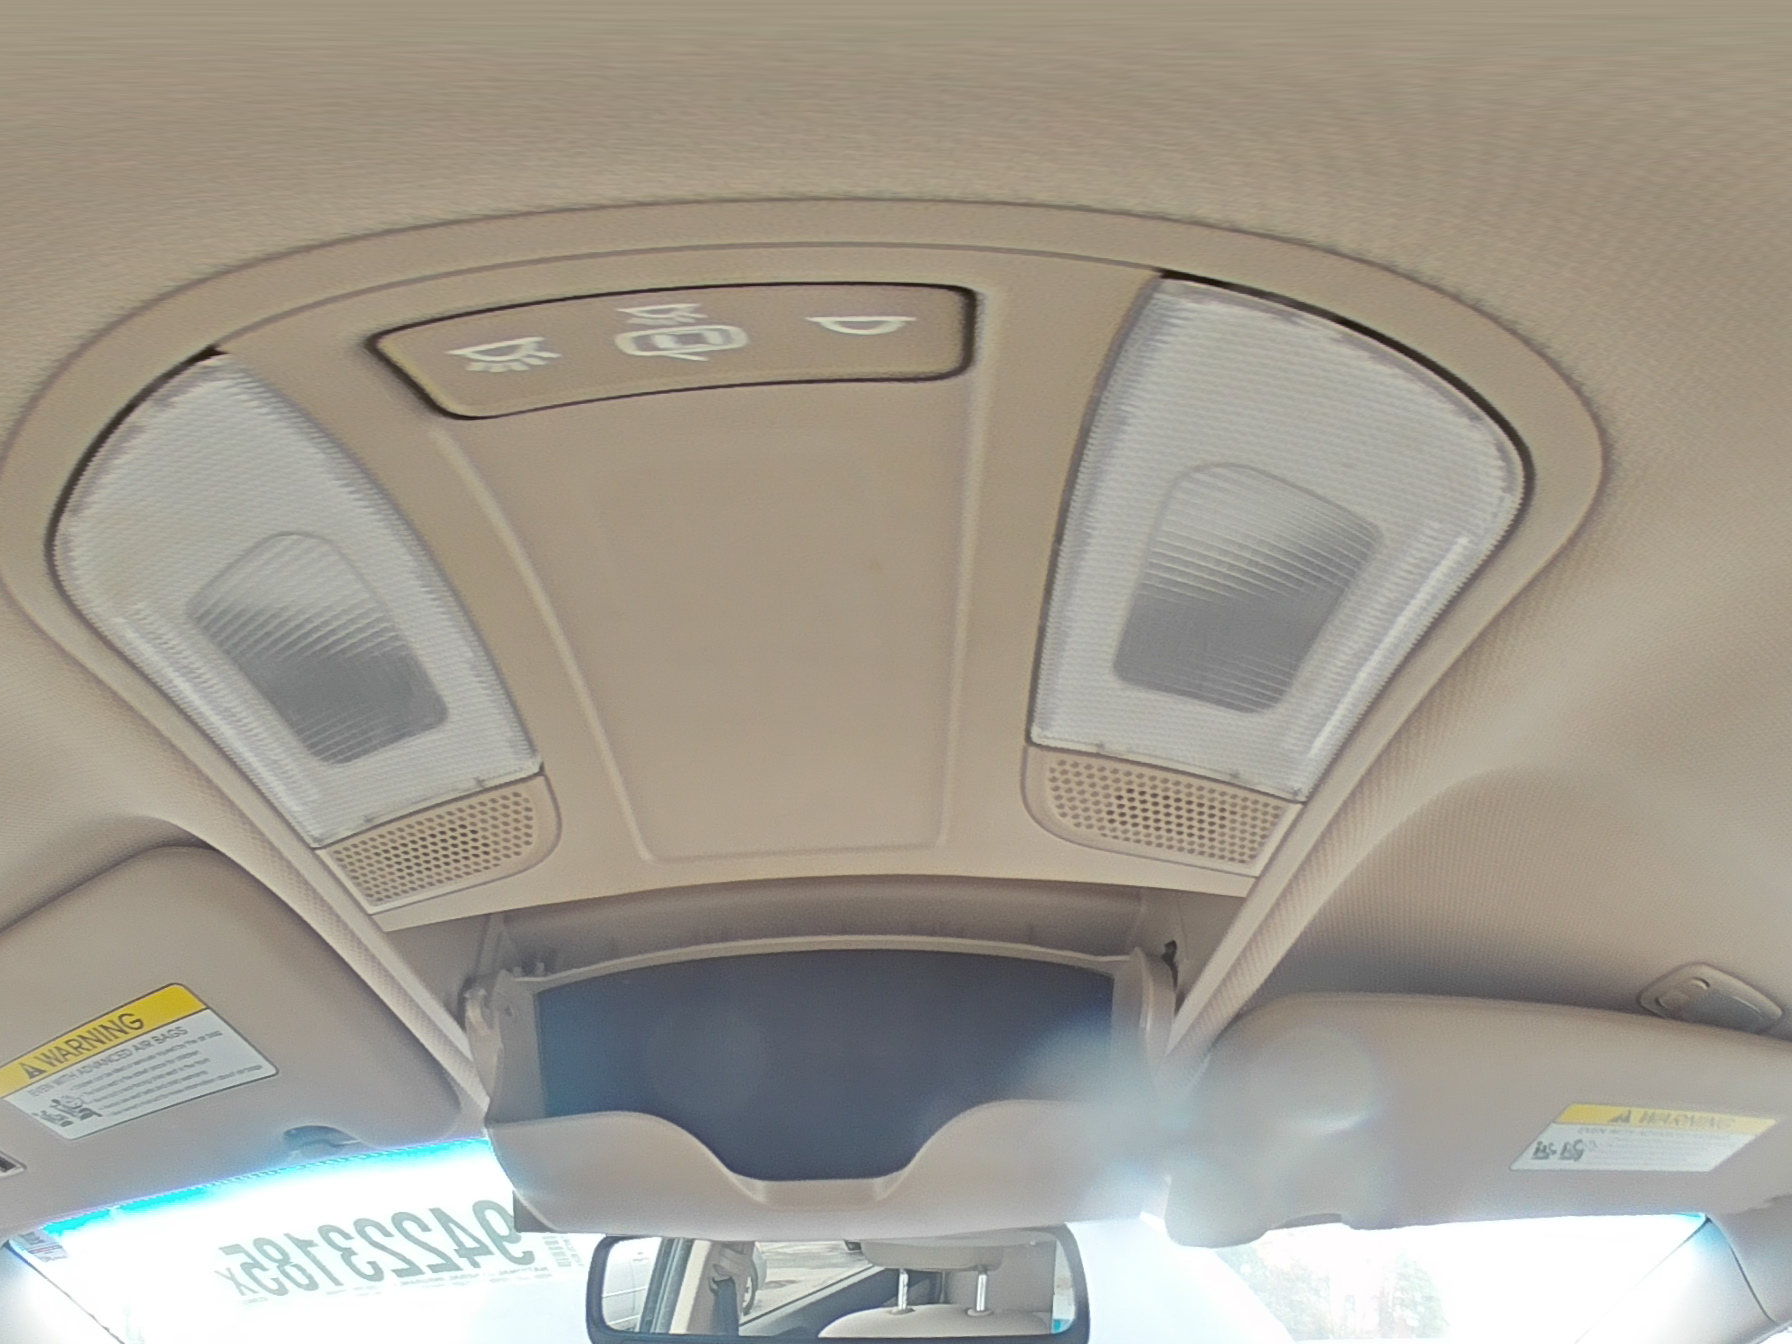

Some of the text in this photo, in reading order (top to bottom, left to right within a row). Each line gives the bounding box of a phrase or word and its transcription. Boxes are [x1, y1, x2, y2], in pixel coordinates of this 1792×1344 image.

[33, 1012, 145, 1068] WARNING
[75, 1049, 133, 1076] ADVANCED
[132, 1039, 154, 1054] AIR
[154, 1025, 189, 1047] BAGS
